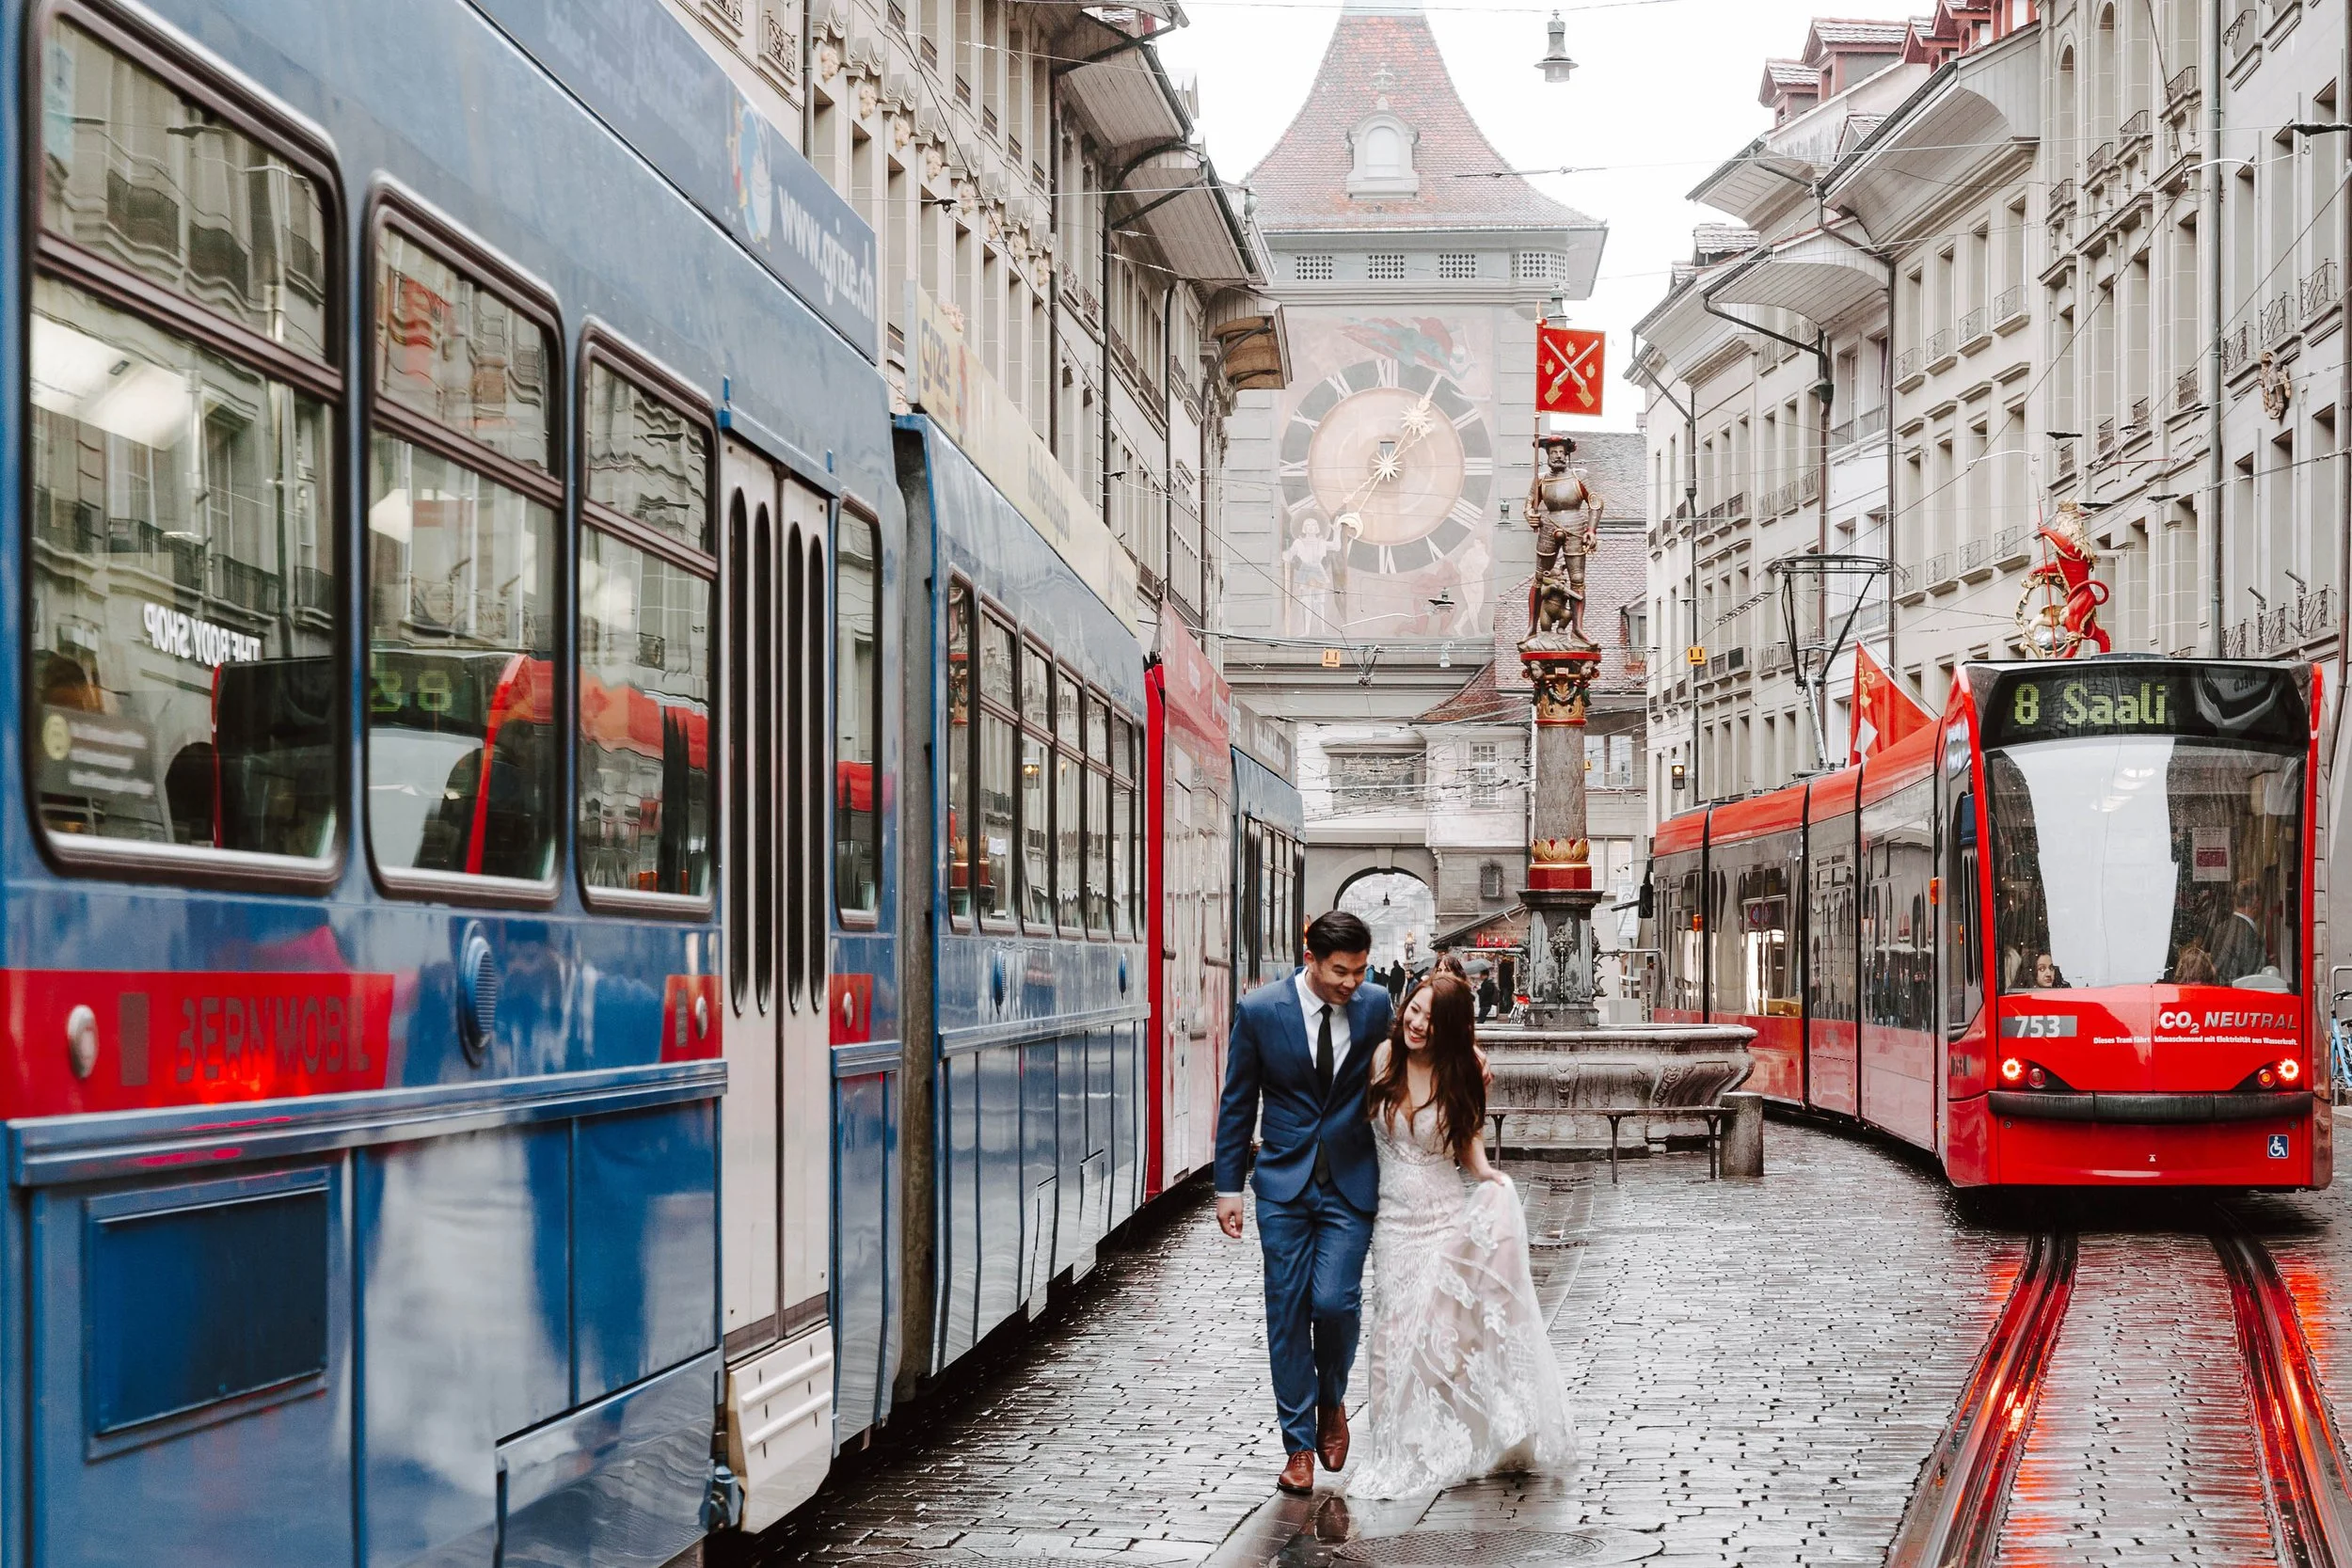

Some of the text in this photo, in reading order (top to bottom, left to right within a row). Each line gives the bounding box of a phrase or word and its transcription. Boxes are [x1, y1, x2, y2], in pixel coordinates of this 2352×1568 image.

[1375, 358, 1399, 388] XII
[1326, 372, 1353, 402] XI
[1292, 407, 1321, 433] X
[1452, 408, 1484, 431] II
[1465, 457, 1492, 475] III
[1424, 534, 1446, 562] V
[2014, 683, 2166, 725] 8 Saali
[2015, 1015, 2060, 1038] 753
[2204, 1011, 2297, 1030] NEUTRAL
[2133, 1036, 2151, 1044] fährt
